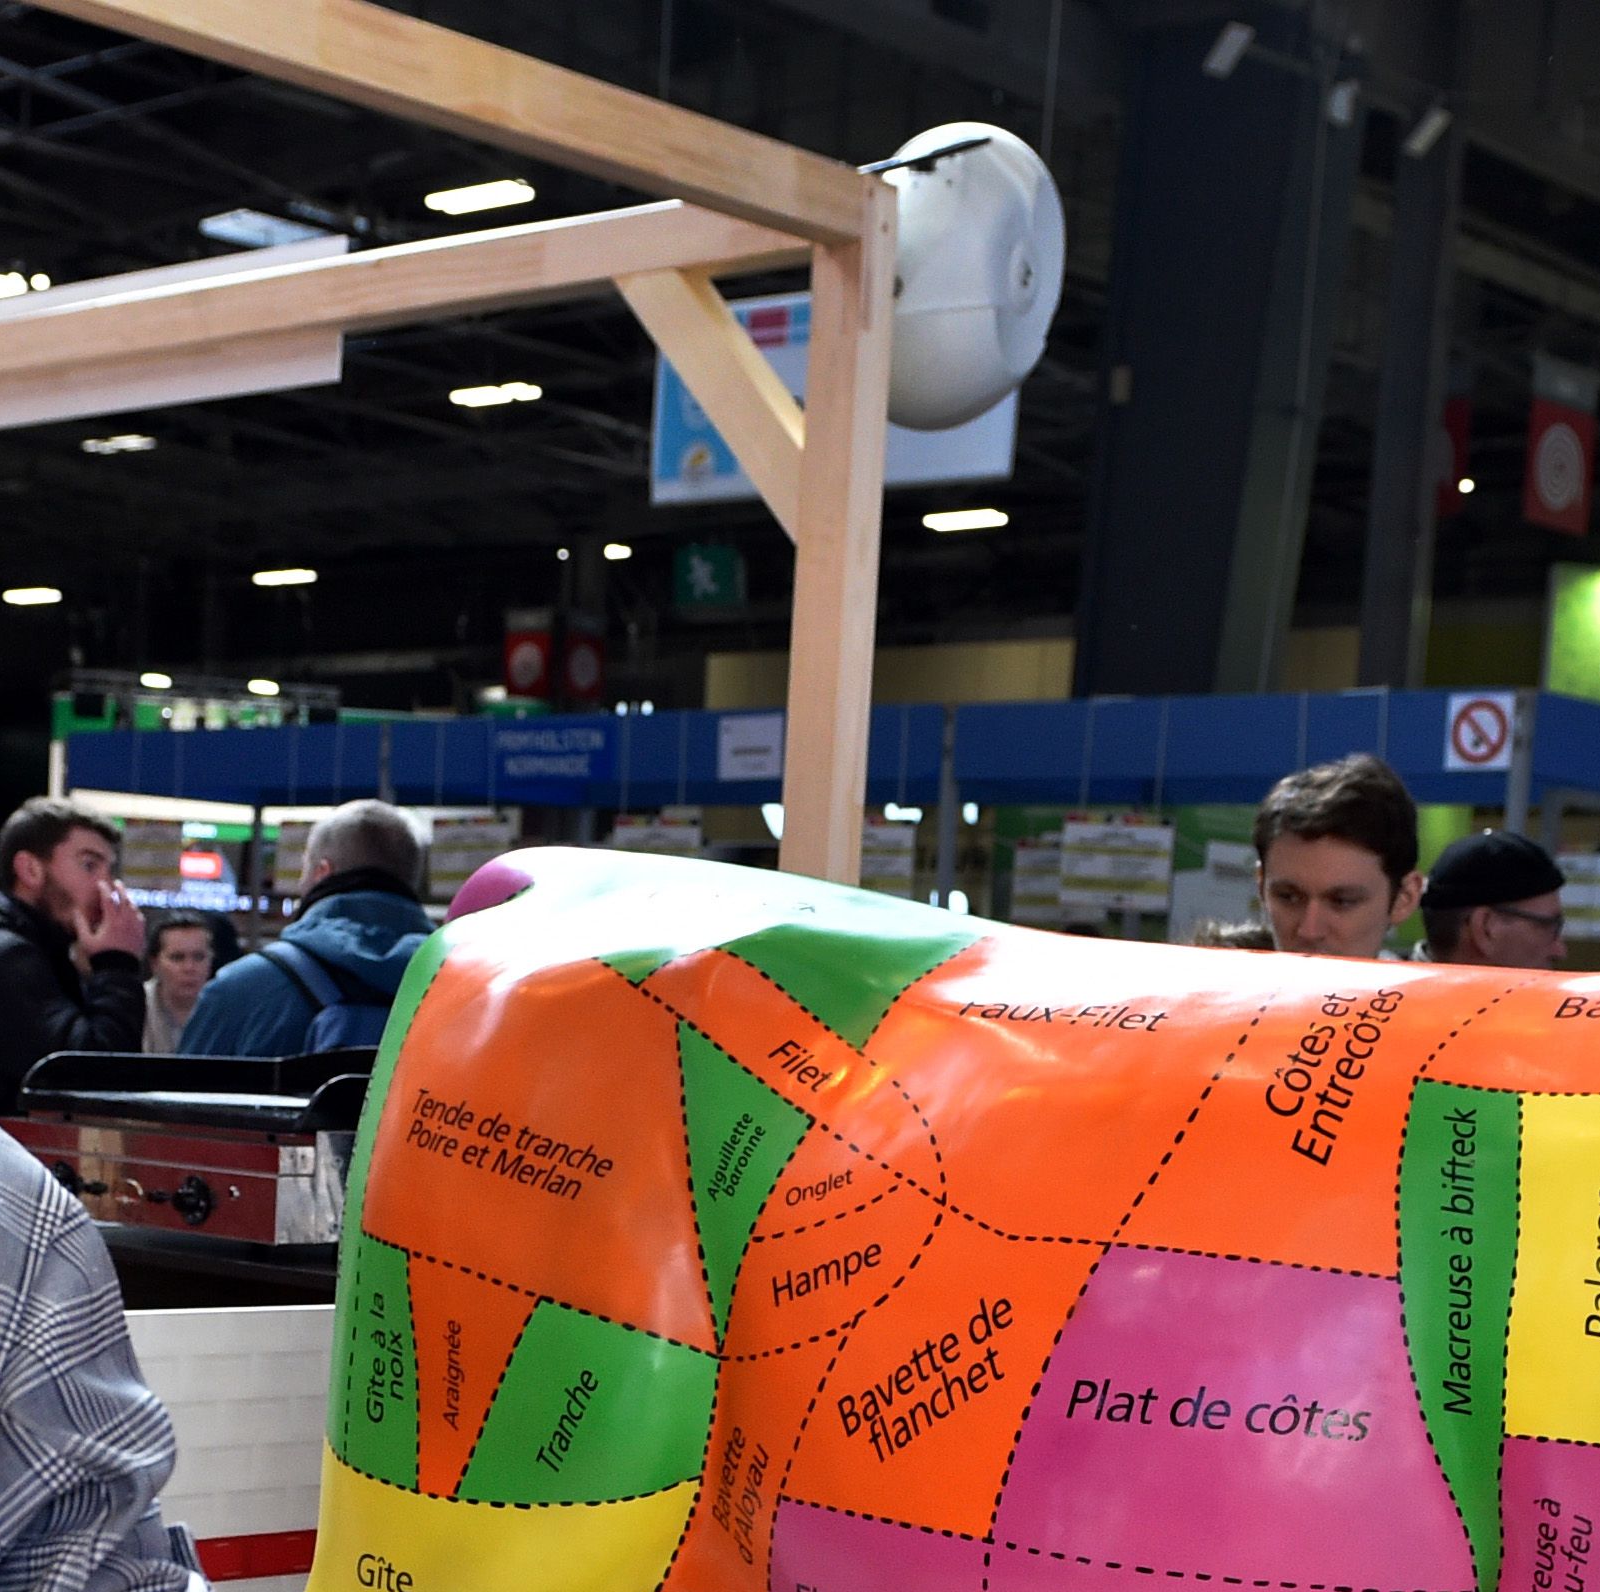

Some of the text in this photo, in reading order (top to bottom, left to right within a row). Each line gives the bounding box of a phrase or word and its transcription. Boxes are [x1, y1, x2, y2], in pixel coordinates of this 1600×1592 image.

[768, 1039, 832, 1093] Filet
[1265, 993, 1357, 1116] Côtes et
[1291, 989, 1403, 1166] Entrecôtes
[406, 1119, 582, 1200] Poire et Merlan
[413, 1089, 614, 1178] Tende de tranche
[707, 1112, 754, 1202] Aiguillette
[722, 1124, 766, 1197] baronne
[785, 1169, 853, 1206] Onglet
[771, 1244, 881, 1307] Hampe
[1441, 1106, 1478, 1416] Macreuse à bifteck
[366, 1292, 386, 1423] Gîte à la
[387, 1330, 404, 1400] noix
[442, 1320, 465, 1431] Araignée
[837, 1297, 1014, 1437] Bavette de
[868, 1346, 1005, 1462] flanchet
[536, 1369, 599, 1473] Tranche
[1066, 1379, 1372, 1443] Plat de côtes
[711, 1426, 746, 1532] Bavette
[734, 1443, 770, 1566] d'Aloyau
[1534, 1497, 1562, 1518] à
